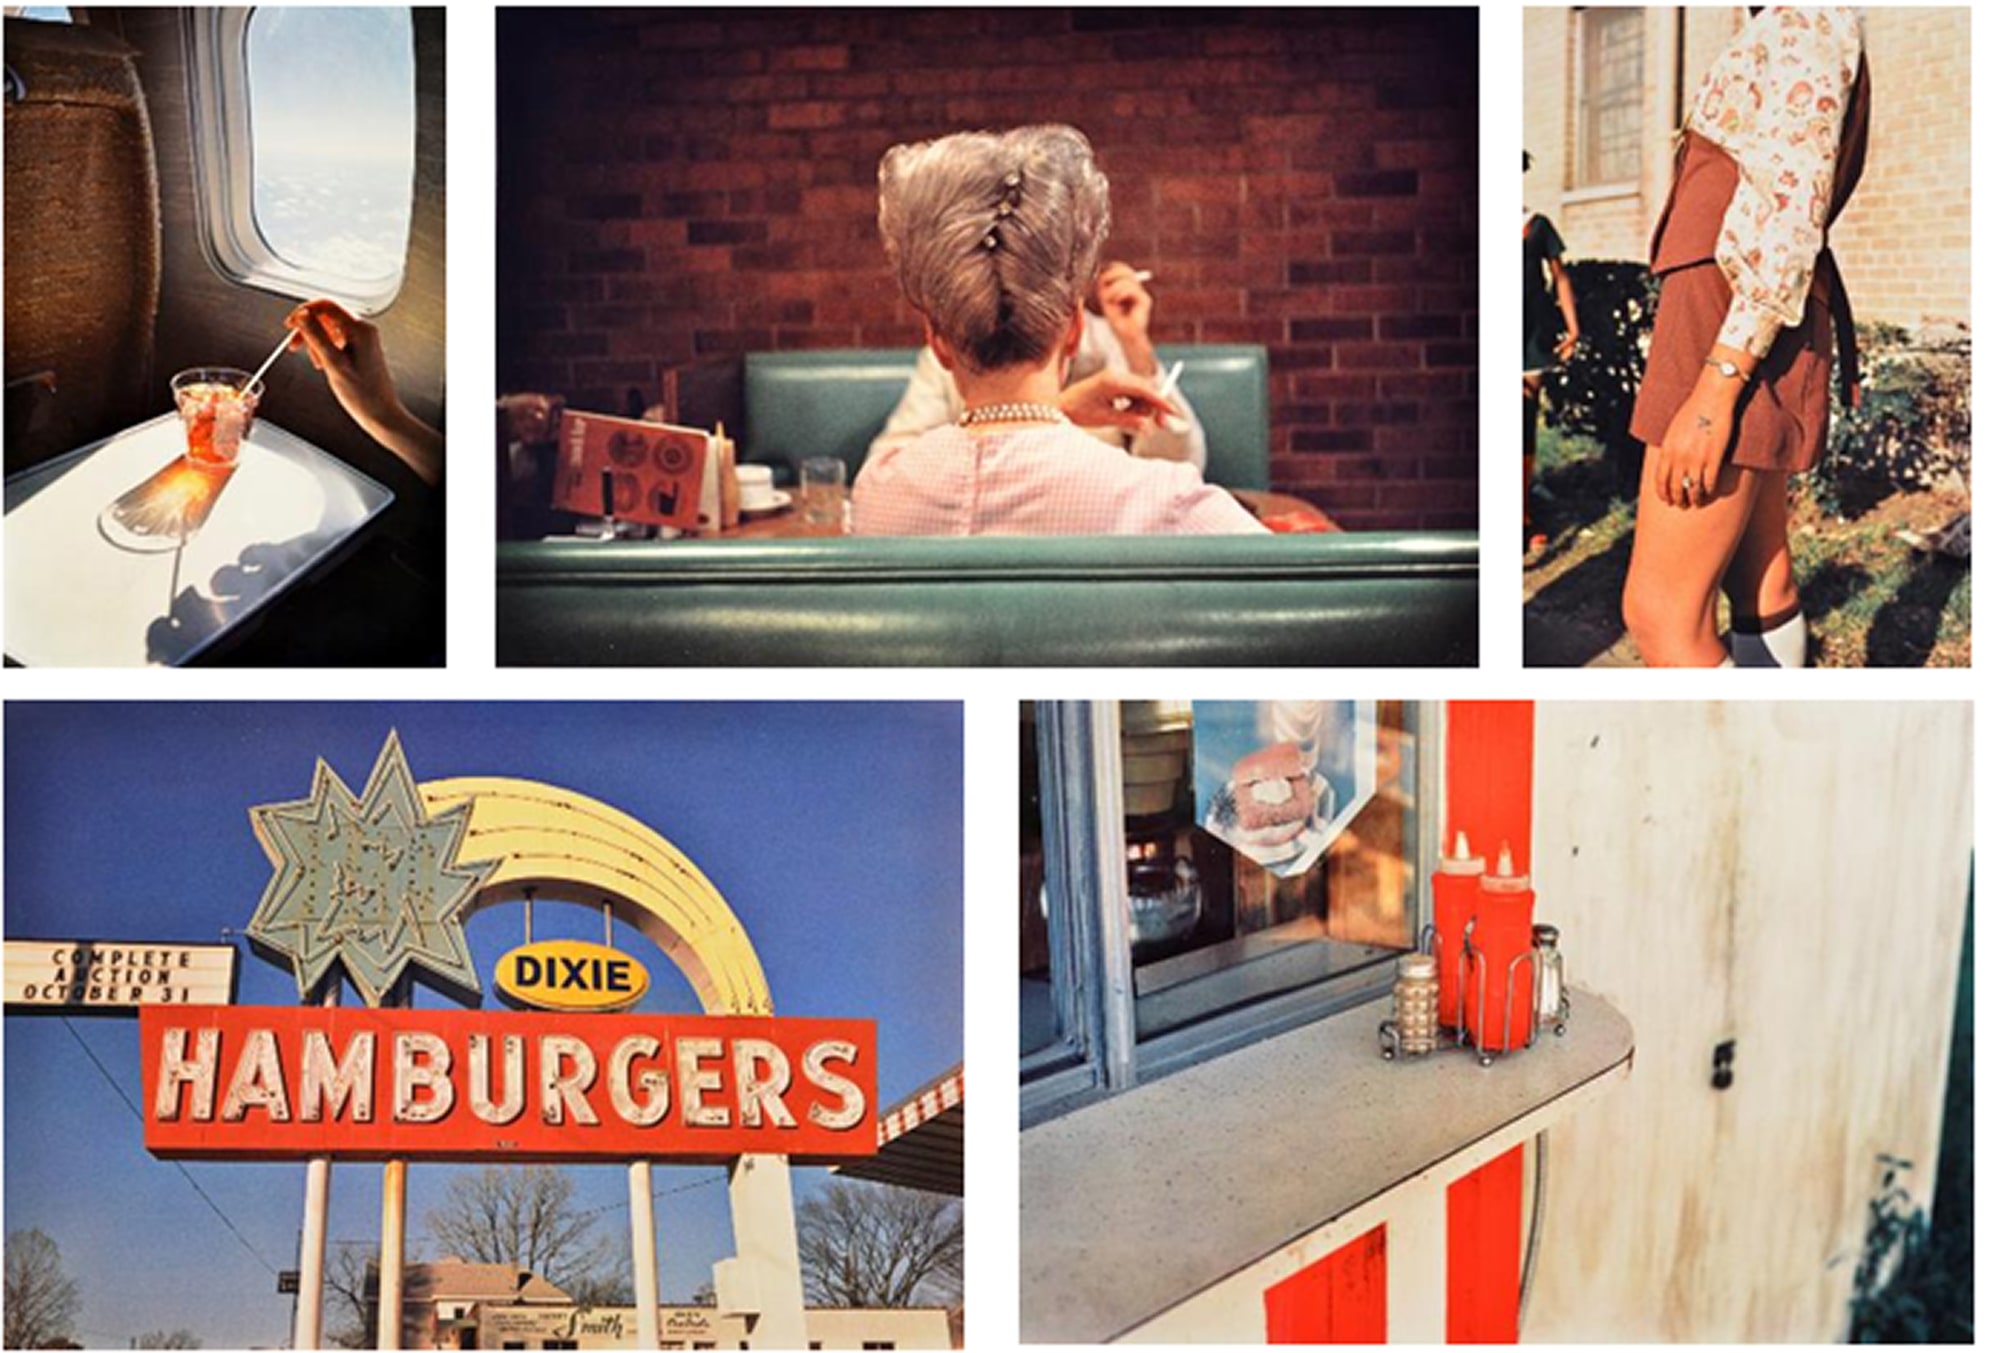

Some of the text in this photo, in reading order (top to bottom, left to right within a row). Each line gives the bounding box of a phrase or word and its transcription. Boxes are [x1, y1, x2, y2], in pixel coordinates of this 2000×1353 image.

[52, 949, 190, 967] COMPLETE
[54, 967, 170, 983] AUCTION
[515, 955, 631, 991] DIXIE
[23, 984, 190, 1001] OCTOBER 31
[155, 1027, 868, 1130] HAMBURGERS
